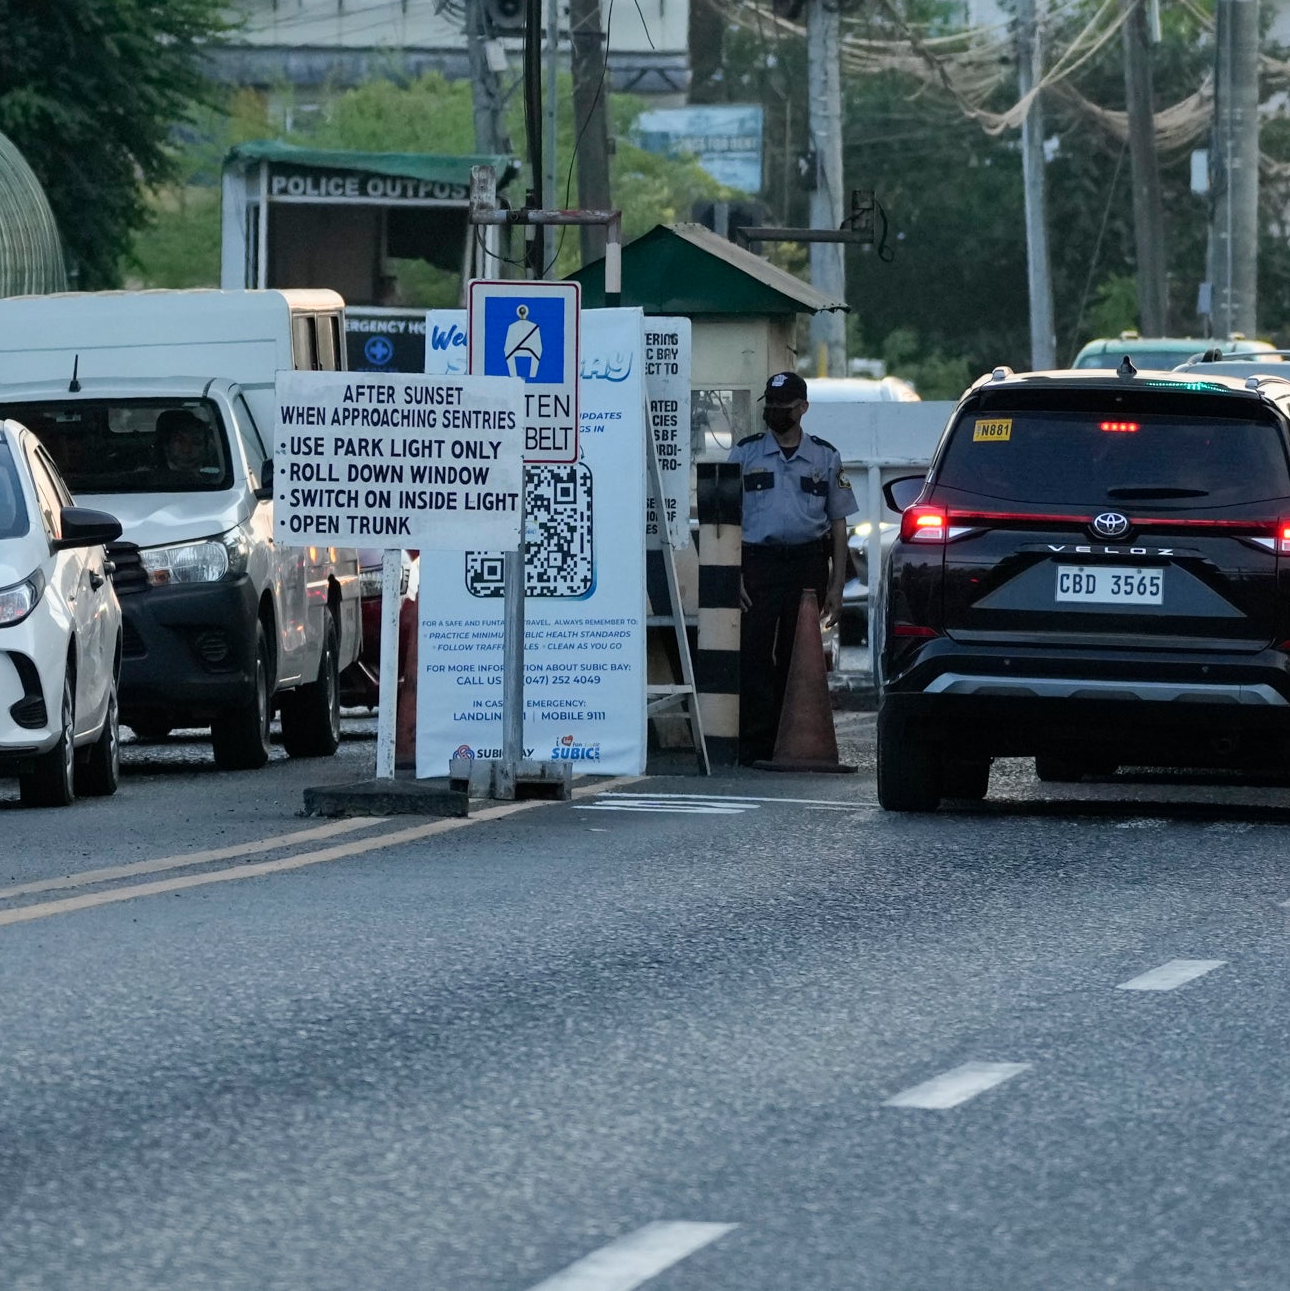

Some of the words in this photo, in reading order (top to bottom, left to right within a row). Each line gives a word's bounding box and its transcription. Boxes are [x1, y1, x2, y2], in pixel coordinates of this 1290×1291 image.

[272, 175, 360, 197] POLICE
[367, 179, 470, 199] OUTPOS
[344, 318, 406, 333] ERGENCY
[657, 348, 678, 360] BAY
[665, 362, 679, 375] TO
[343, 385, 395, 404] AFTER
[404, 386, 463, 405] SUNSET
[524, 394, 571, 418] TEN
[281, 406, 325, 425] WHEN
[331, 407, 437, 428] APPROACHING
[442, 410, 516, 430] SENTRIES
[580, 412, 622, 420] PDATES
[594, 425, 605, 433] IN
[981, 423, 1009, 436] N881
[525, 426, 574, 452] BELT
[290, 437, 324, 456] USE
[334, 438, 384, 457] PARK
[391, 439, 445, 458] LIGHT
[452, 441, 502, 460] ONLY
[290, 463, 339, 482] ROLL
[348, 465, 403, 483] DOWN
[411, 466, 489, 485] WINDOW
[290, 489, 359, 508] SWITCH
[365, 490, 391, 509] ON
[399, 491, 457, 510] INSIDE
[465, 493, 518, 511] LIGHT
[290, 514, 339, 533] OPEN
[347, 516, 411, 535] TRUNK
[1047, 544, 1174, 556] VELOZ
[1060, 573, 1096, 594] CBD
[1111, 575, 1160, 596] 3565
[476, 643, 504, 651] TRAFFI
[457, 676, 484, 685] CALL
[487, 676, 501, 685] US
[552, 676, 570, 684] 252
[573, 676, 601, 684] 4049
[453, 712, 502, 721] LANDLIN
[542, 712, 583, 720] MOBILE
[587, 712, 605, 720] 9111
[477, 749, 502, 758] SUBI
[551, 747, 594, 760] SUBIC
